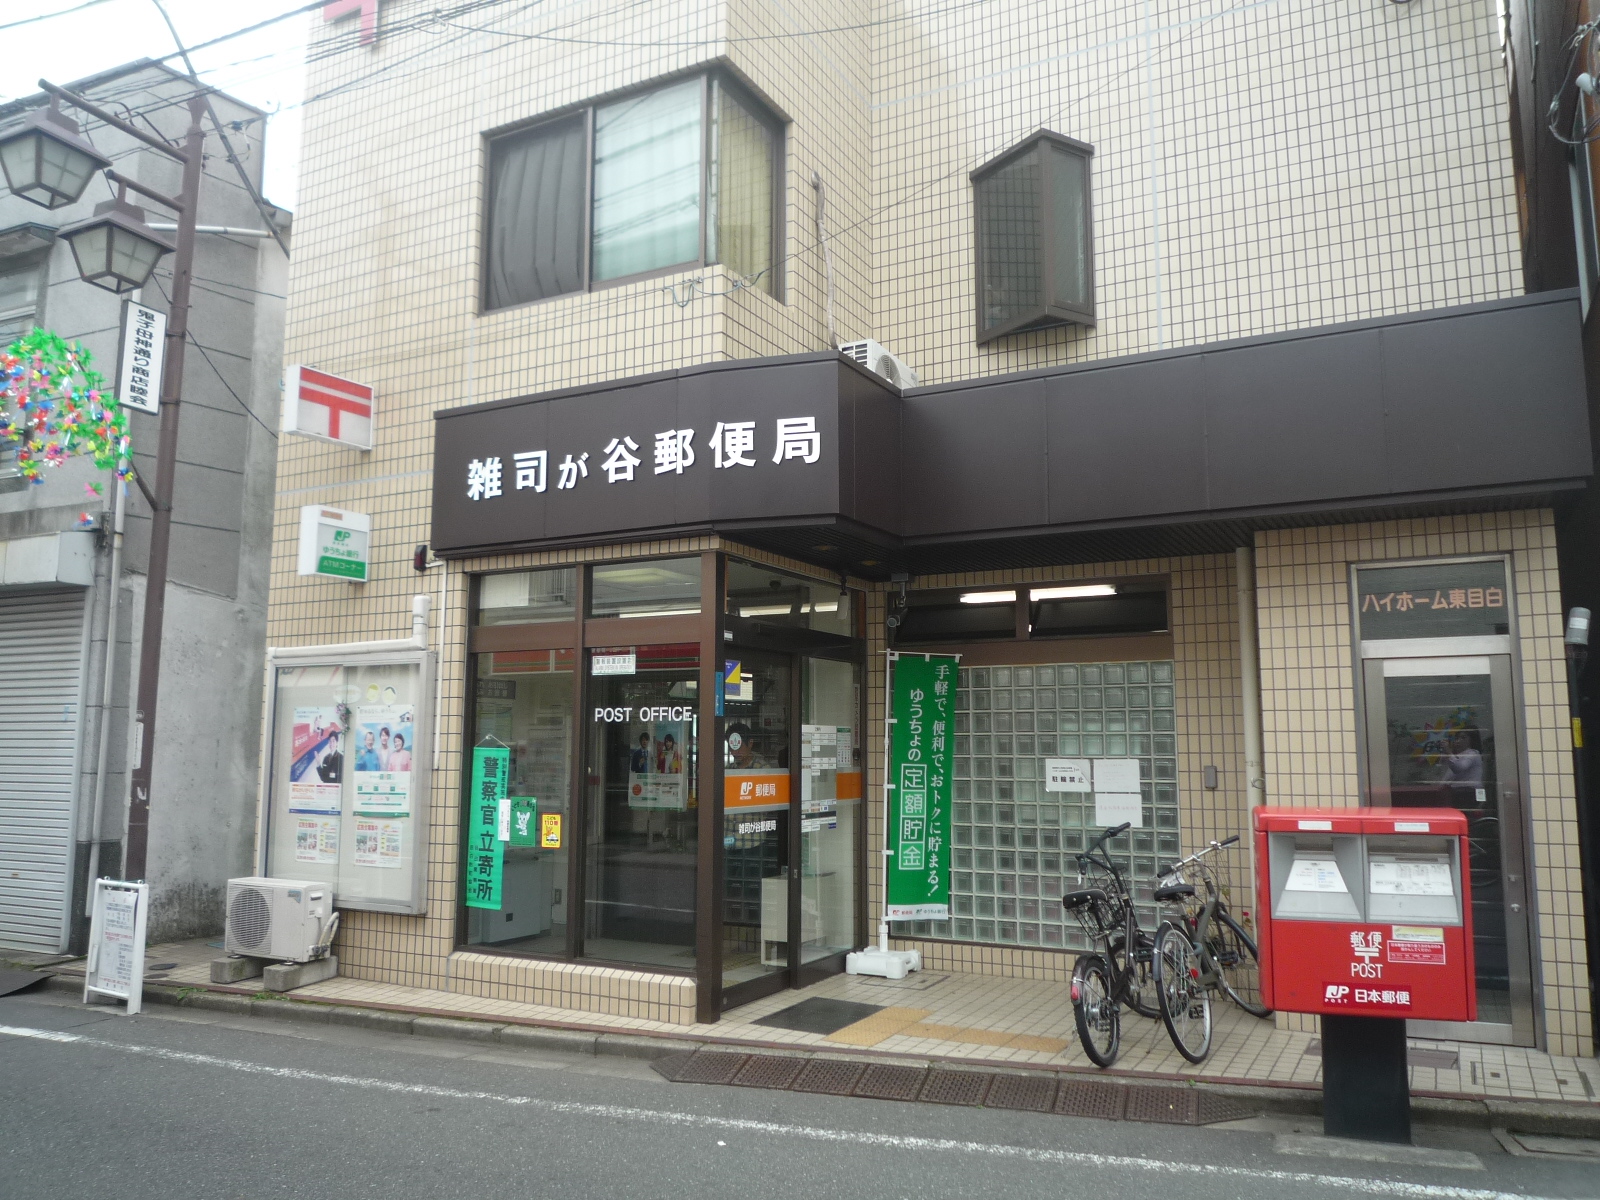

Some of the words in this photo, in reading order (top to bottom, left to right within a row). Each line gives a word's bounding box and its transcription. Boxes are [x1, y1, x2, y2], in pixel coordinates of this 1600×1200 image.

[466, 415, 822, 501] 雑司が谷郵便局
[1361, 586, 1504, 613] ハイホーム東目白
[594, 707, 633, 723] POST
[639, 706, 693, 722] OFFICE
[755, 783, 776, 797] 郵便局
[476, 756, 500, 901] 警察官立寄所
[738, 820, 777, 834] 雑司が谷郵便局
[1350, 930, 1383, 949] 郵便
[1350, 962, 1384, 979] POST
[1354, 989, 1411, 1006] 日本郵便
